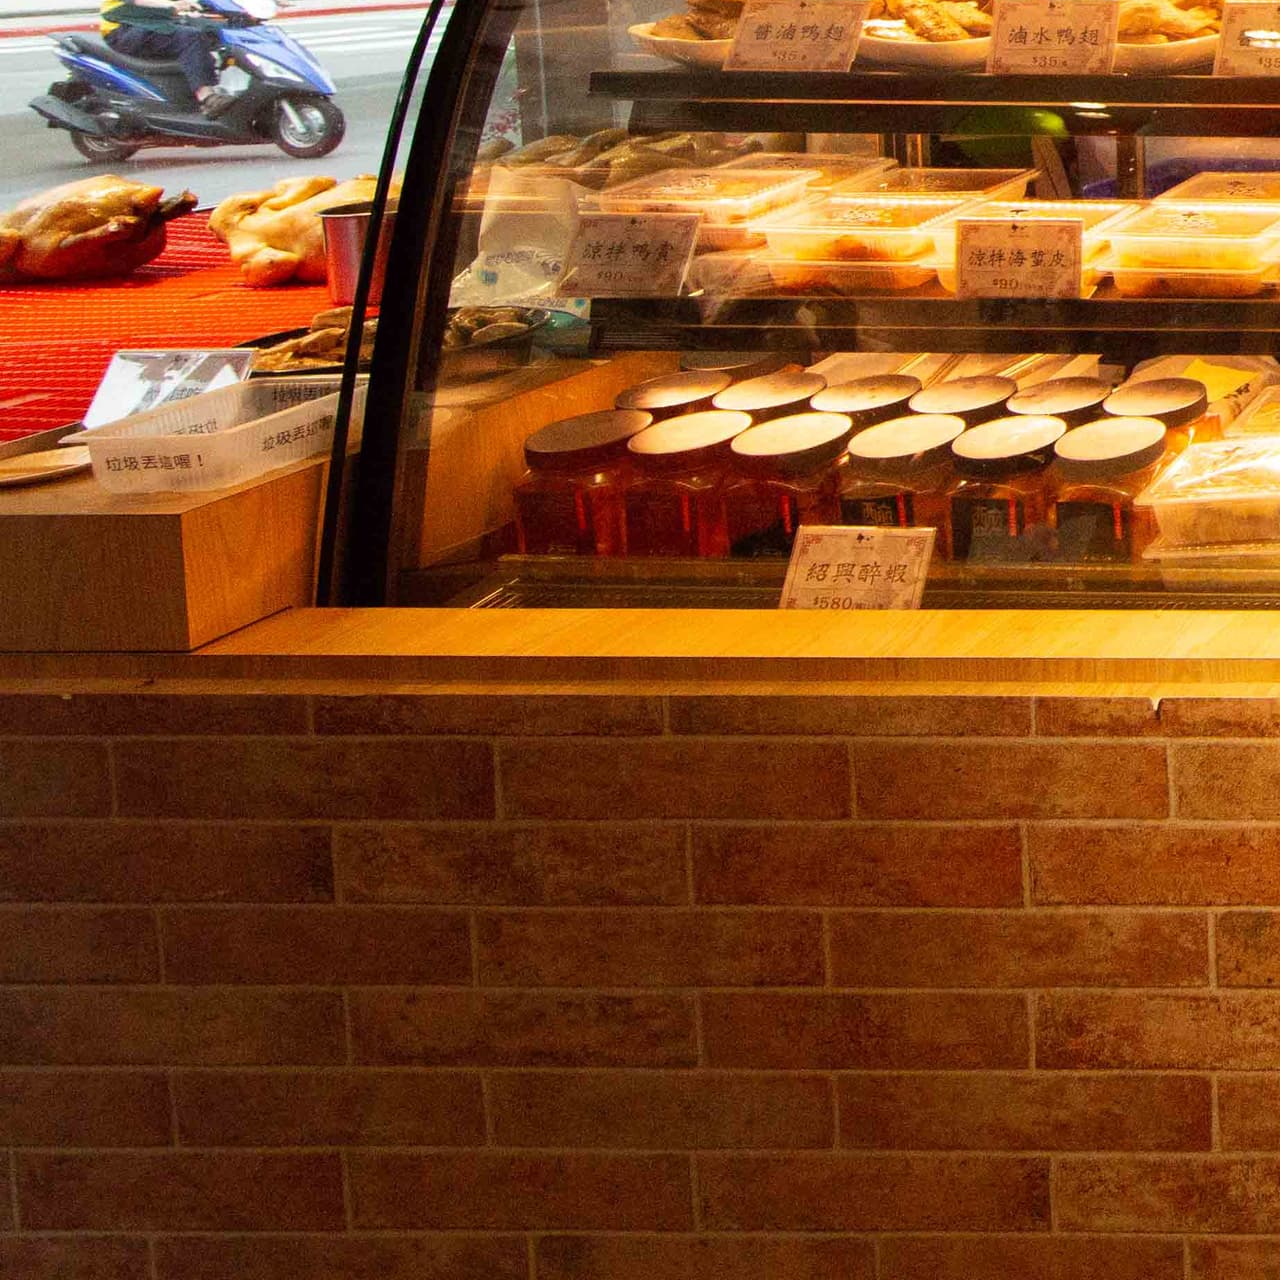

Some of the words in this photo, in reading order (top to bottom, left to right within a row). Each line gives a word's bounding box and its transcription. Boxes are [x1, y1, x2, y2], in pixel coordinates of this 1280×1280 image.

[1008, 26, 1099, 45] 滷水鴨翅
[805, 561, 909, 585] 紹興醉蝦
